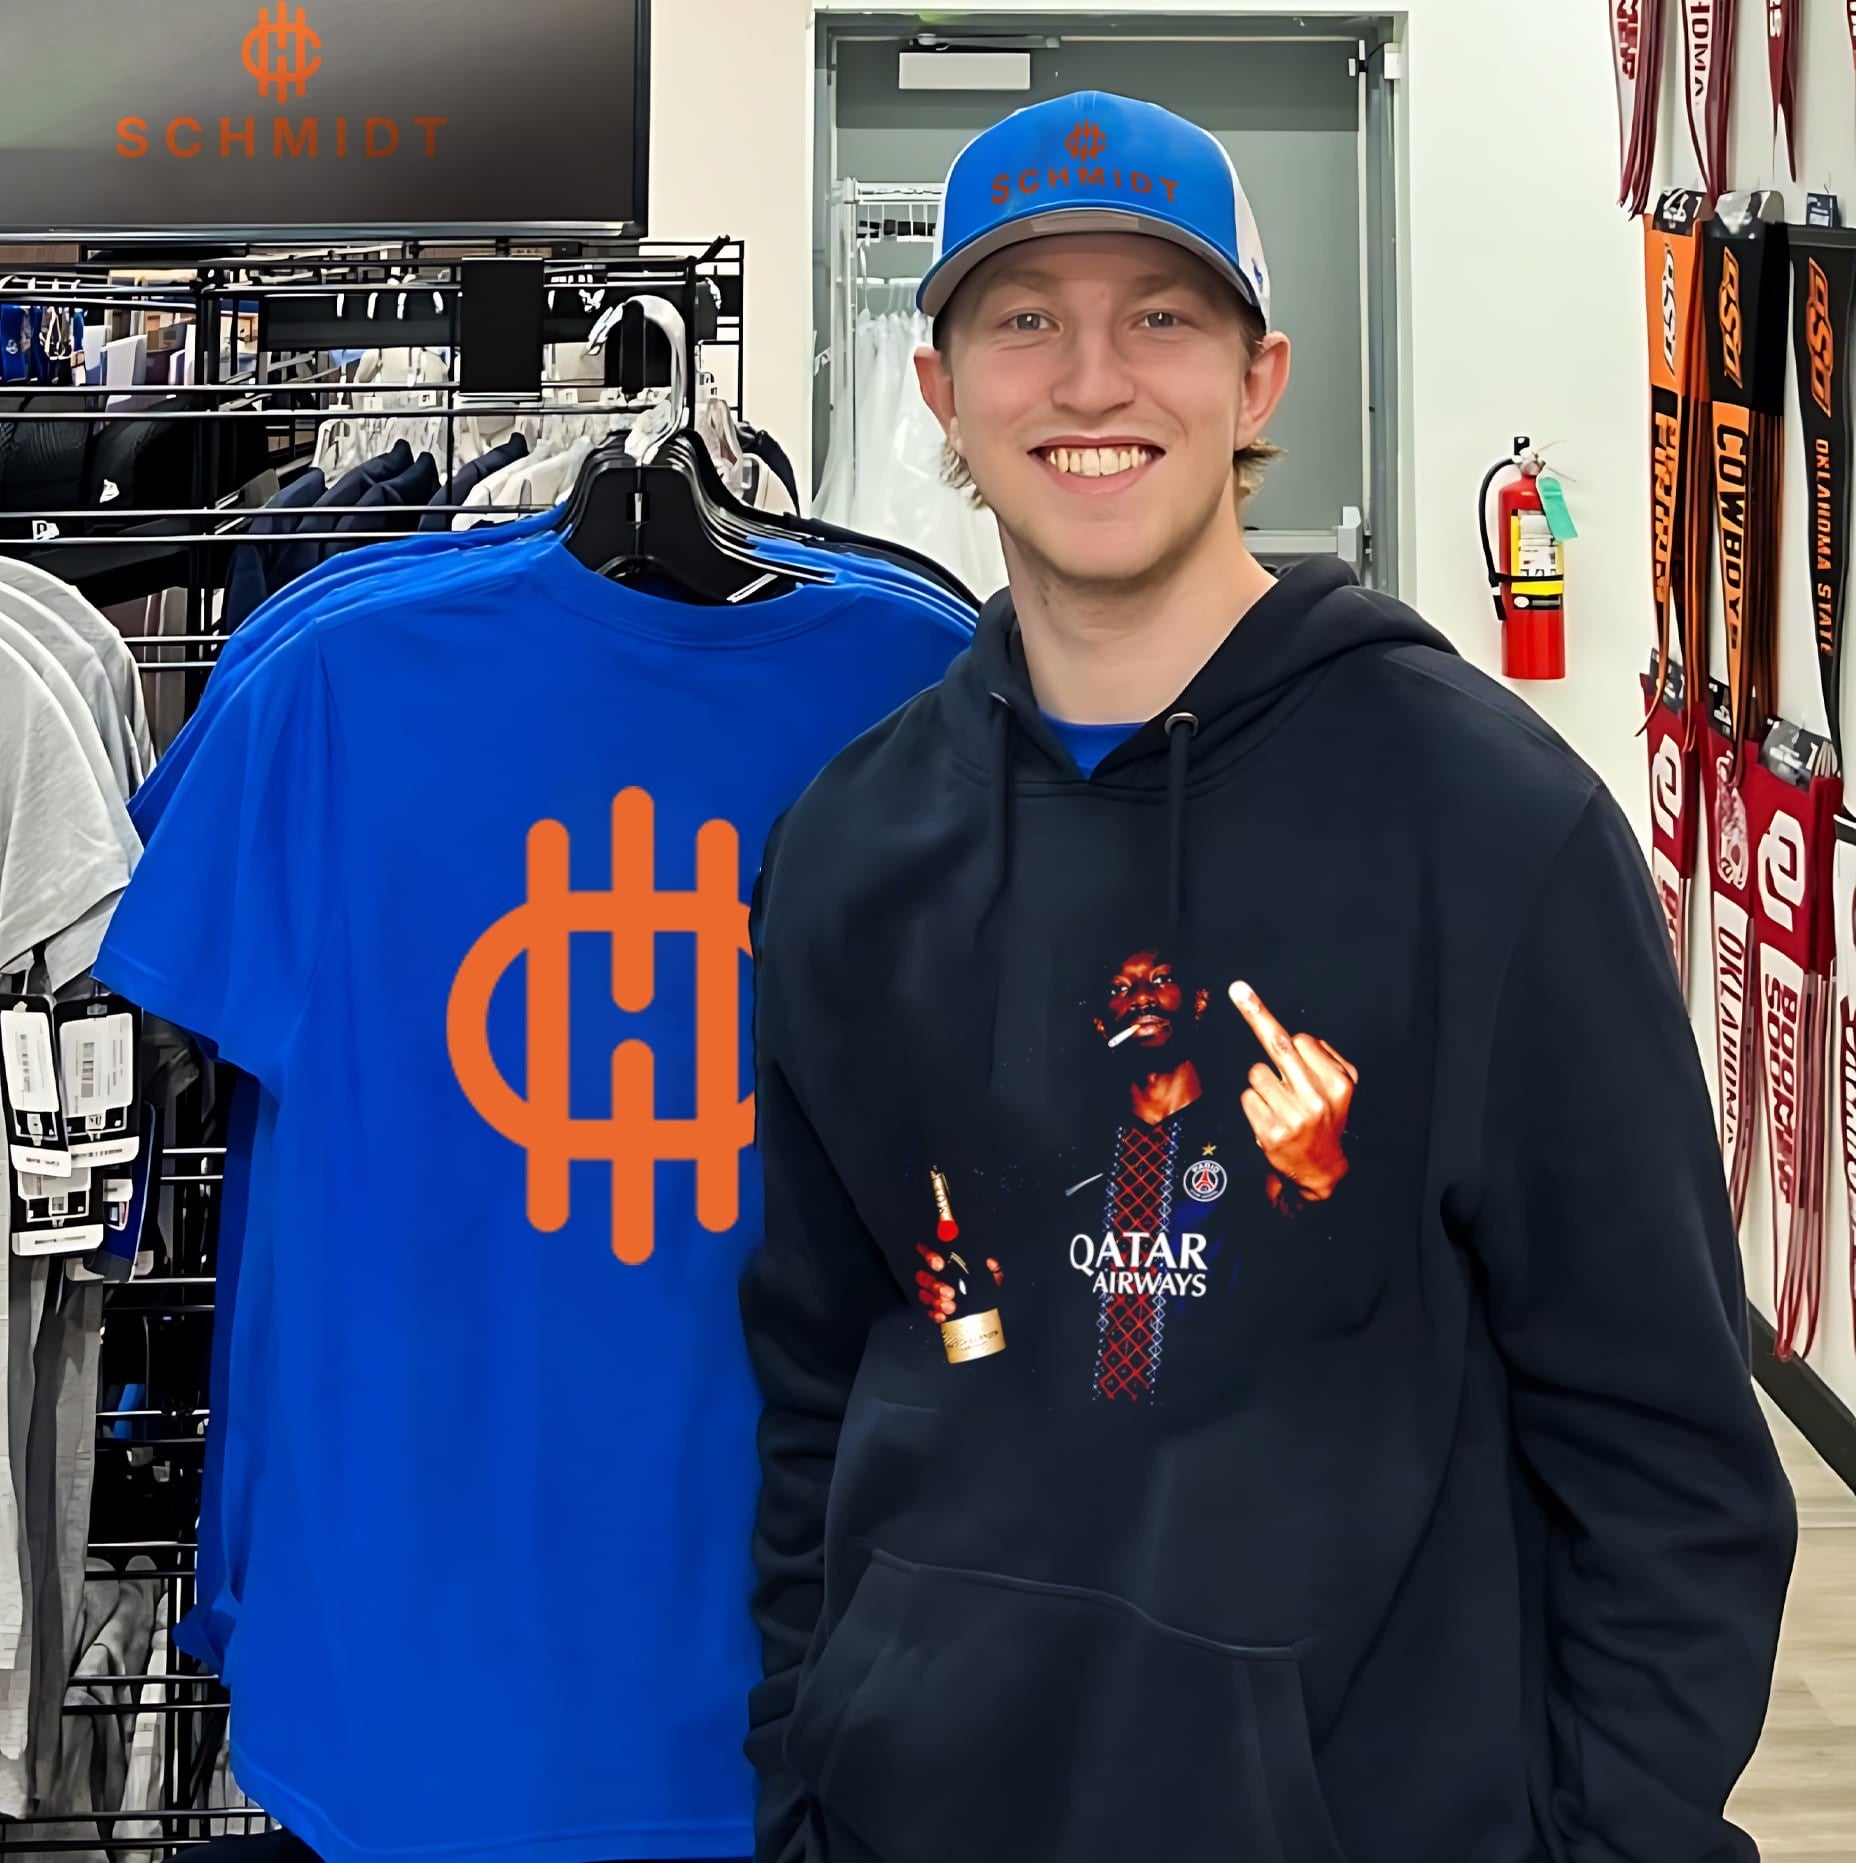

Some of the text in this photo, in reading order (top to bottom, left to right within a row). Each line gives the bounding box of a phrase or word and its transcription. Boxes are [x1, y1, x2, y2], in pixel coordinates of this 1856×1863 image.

[116, 116, 447, 158] SCHMIDT
[991, 166, 1179, 205] SCHMIDT
[1816, 438, 1833, 570] OKLAHOMA
[1069, 1231, 1208, 1277] QATAR
[1092, 1270, 1207, 1297] AIRWAYS
